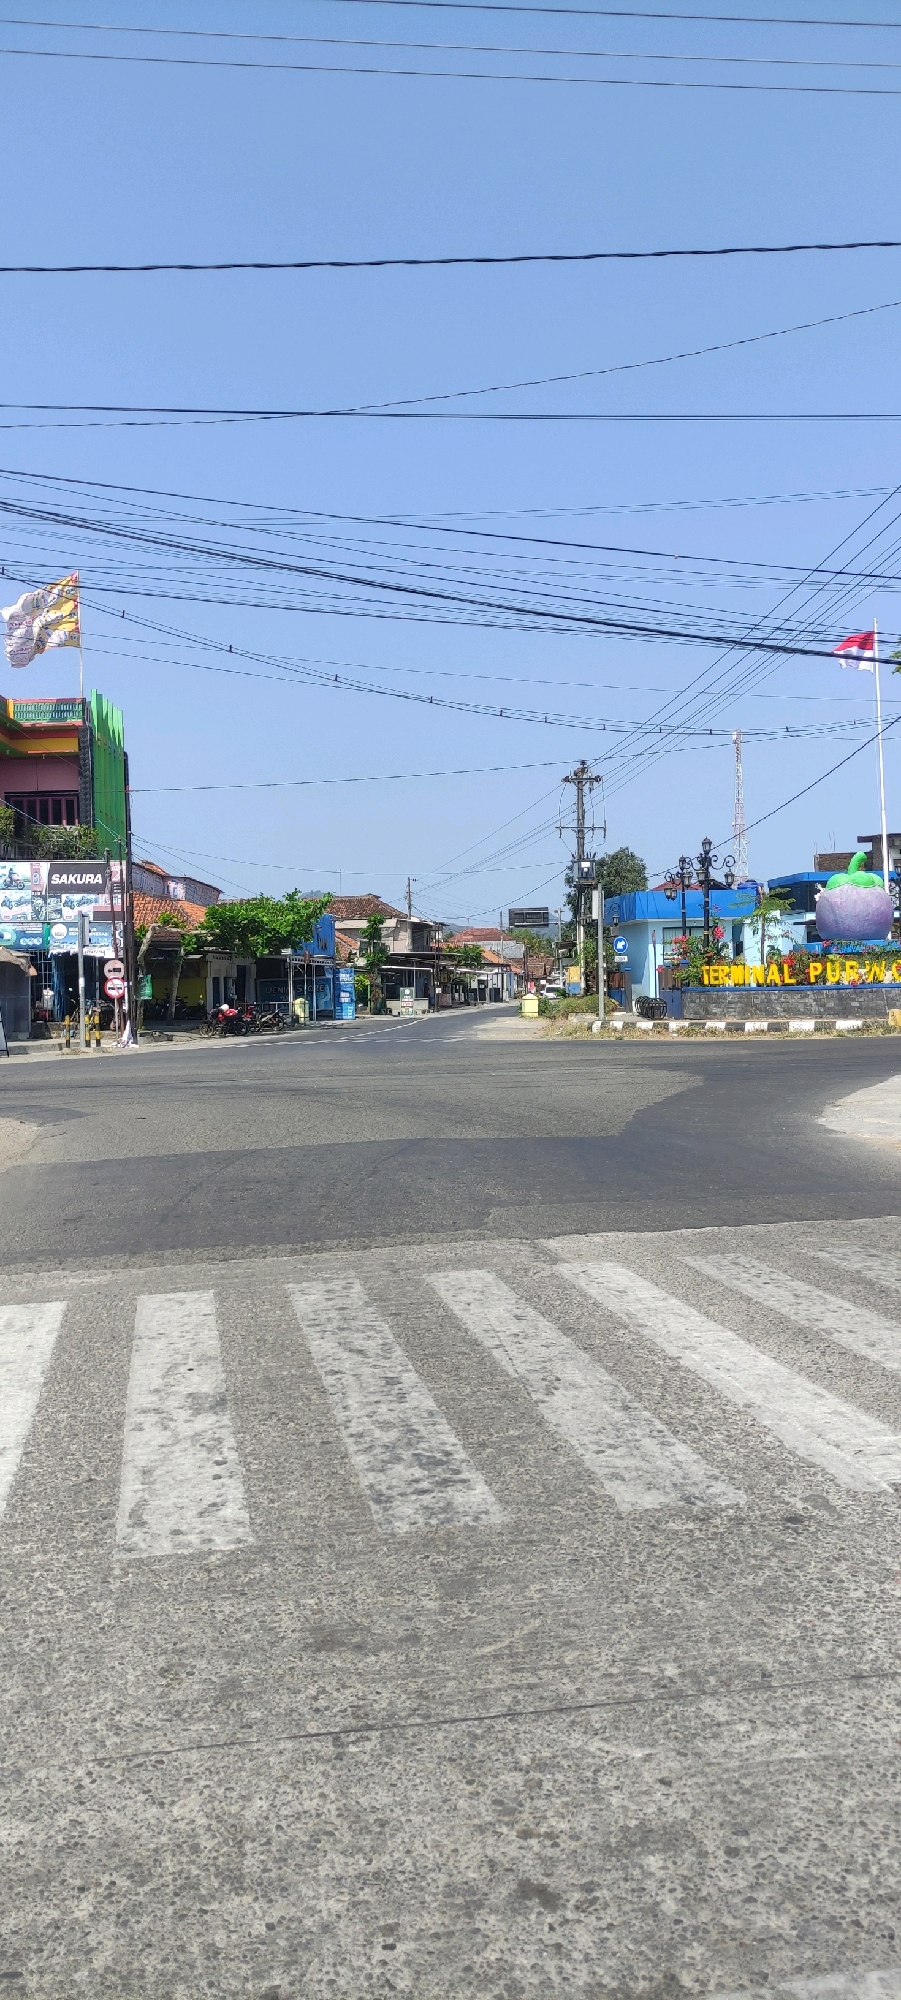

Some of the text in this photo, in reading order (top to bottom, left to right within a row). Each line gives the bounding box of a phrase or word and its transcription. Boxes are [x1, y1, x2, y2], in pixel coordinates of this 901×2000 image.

[51, 873, 103, 885] SAKURA
[702, 963, 797, 985] TERMINAL
[296, 984, 325, 993] SORE
